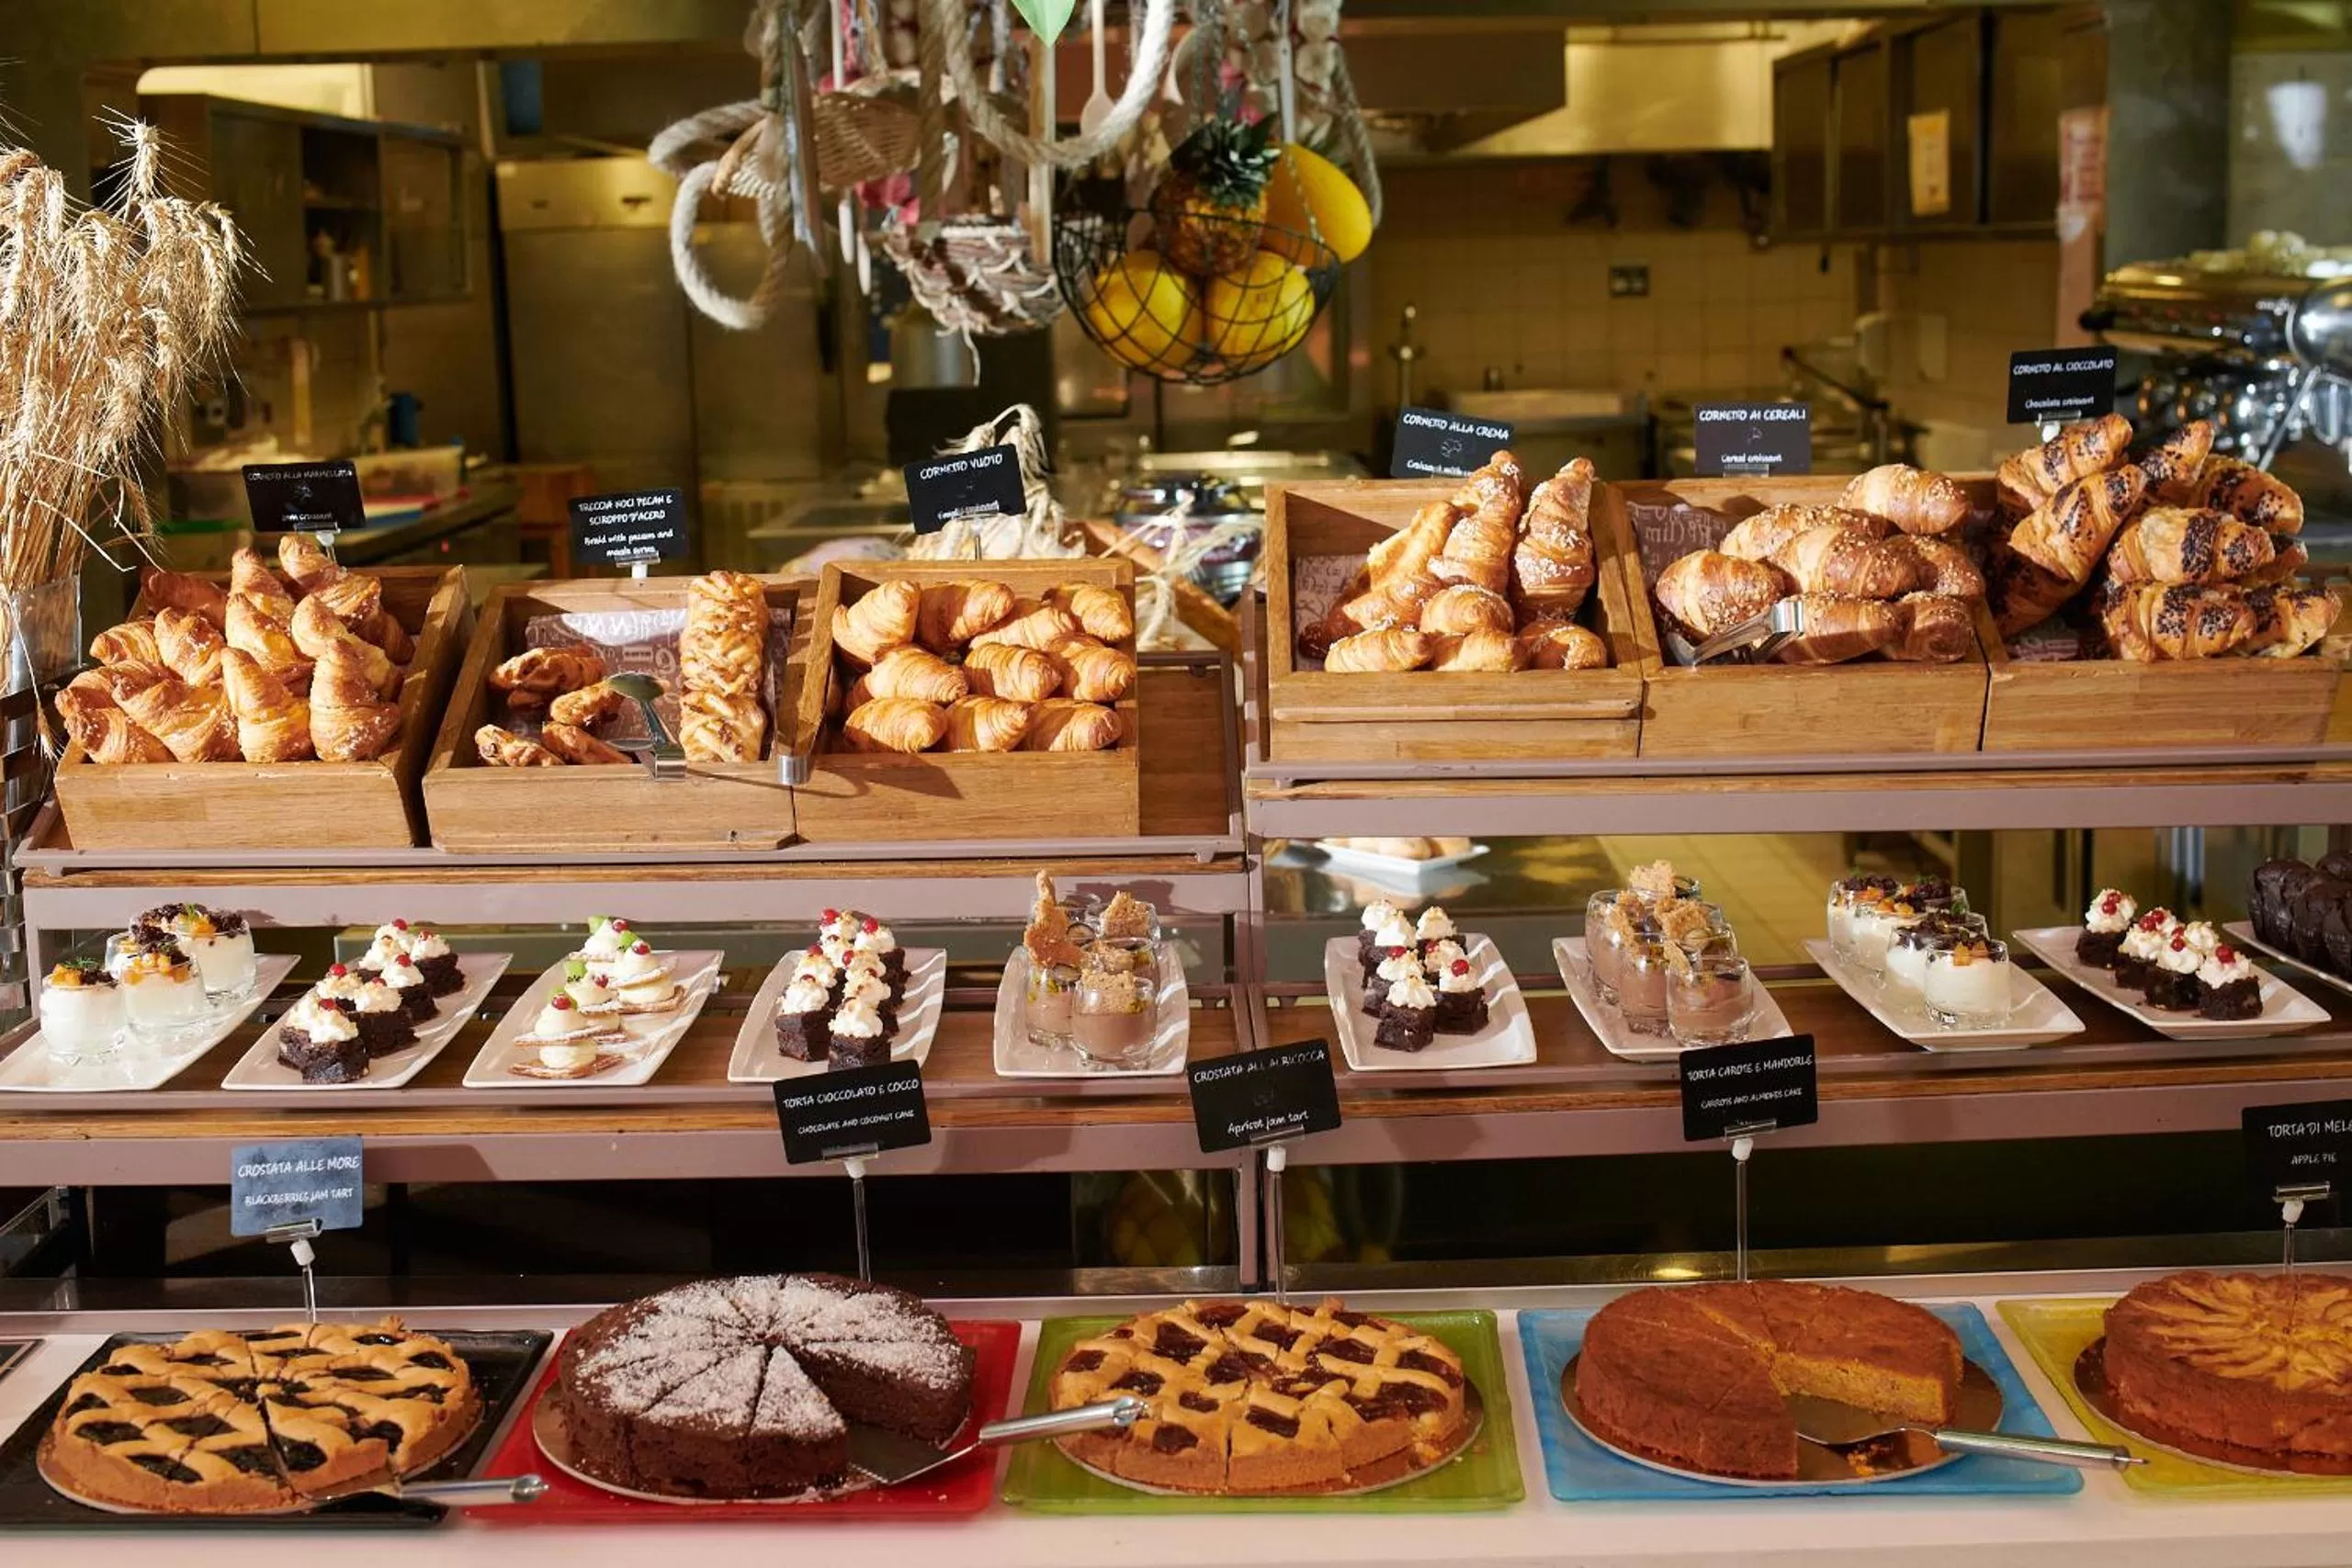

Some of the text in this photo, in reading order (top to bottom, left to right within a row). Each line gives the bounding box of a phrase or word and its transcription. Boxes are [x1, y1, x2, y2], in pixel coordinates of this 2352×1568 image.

[2013, 358, 2114, 376] CORNETTO AL CIOCCOLATO
[2025, 397, 2061, 409] Chocolate
[1699, 409, 1806, 422] CORNETTO AI CEREALI
[1402, 412, 1510, 441] CORNETTO ALLA CREMA
[920, 454, 1003, 480] CORNETTO VUOTO
[1721, 452, 1747, 464] Cereal
[578, 494, 673, 513] TRECCIA NOCI PECAN E
[589, 513, 628, 526] SCIROPPO
[607, 532, 627, 543] with
[656, 527, 673, 539] and
[1193, 1064, 1243, 1084] CROSTATA
[1687, 1055, 1813, 1082] TORTA CAROTE E MANDORLE
[783, 1077, 920, 1110] TORTA CIOCCOLATO E COCCO
[1701, 1088, 1803, 1110] CARROTS AND ALMONDS CAKE
[797, 1109, 915, 1135] CHOCOLATE AND COCONUT CAKE
[1227, 1110, 1309, 1138] Apricot jam tart
[2267, 1122, 2305, 1138] TORTA
[2306, 1122, 2321, 1135] DI
[238, 1156, 360, 1178] CROSTATA ALLE MORE
[2290, 1151, 2337, 1165] APPLE PIE
[244, 1188, 354, 1207] BLACKBERRIES JAM TART
